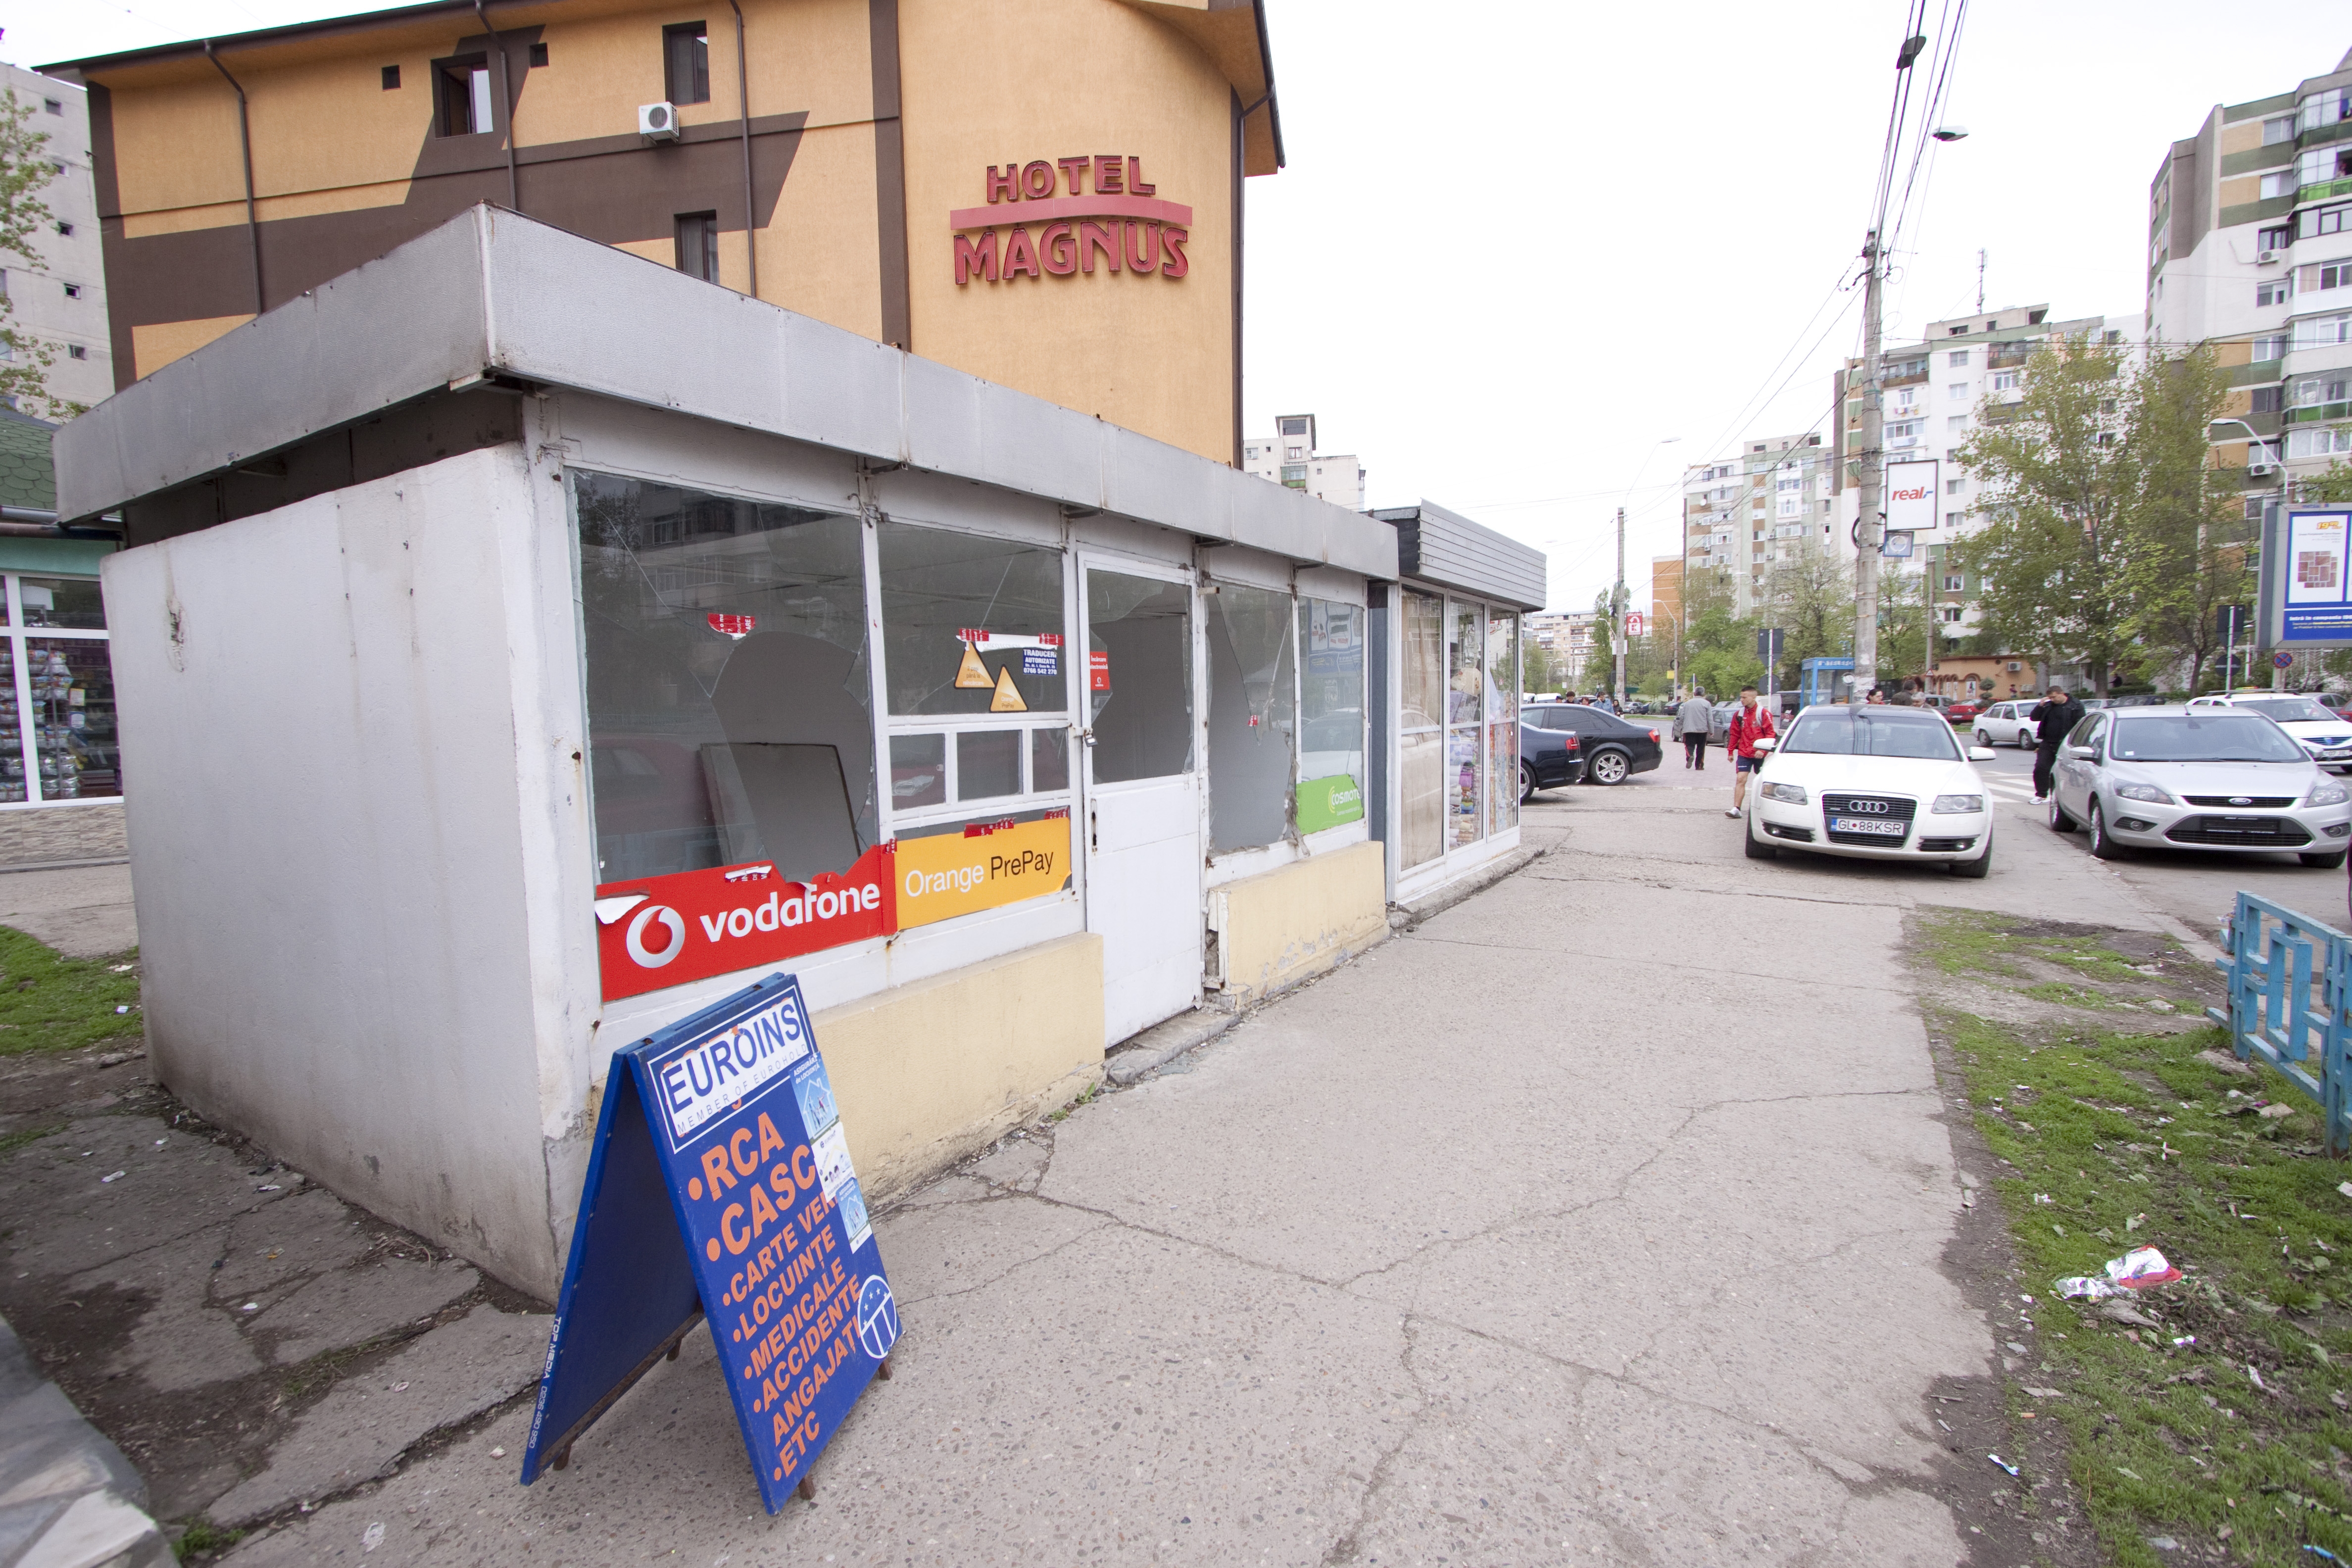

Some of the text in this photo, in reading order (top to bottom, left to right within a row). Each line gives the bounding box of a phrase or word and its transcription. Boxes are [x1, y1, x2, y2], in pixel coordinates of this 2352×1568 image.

[986, 155, 1156, 203] HOTEL
[953, 220, 1188, 286] MAGNUS
[700, 883, 880, 942] vodafone
[905, 850, 1054, 897] Orange PrePay
[663, 1004, 800, 1115] EUROINS
[677, 1044, 807, 1134] MEMBER OF EUROHOLD
[700, 1112, 785, 1202] RCA
[721, 1144, 816, 1255] CASC
[731, 1222, 798, 1303] CARTE
[739, 1224, 836, 1341] LOCUINȚE
[750, 1256, 846, 1378] MEDICALE
[762, 1274, 861, 1413] ACCIDENTE
[529, 1317, 562, 1449] TOP MEDIA 0236 490 950
[779, 1411, 820, 1477] ETC
